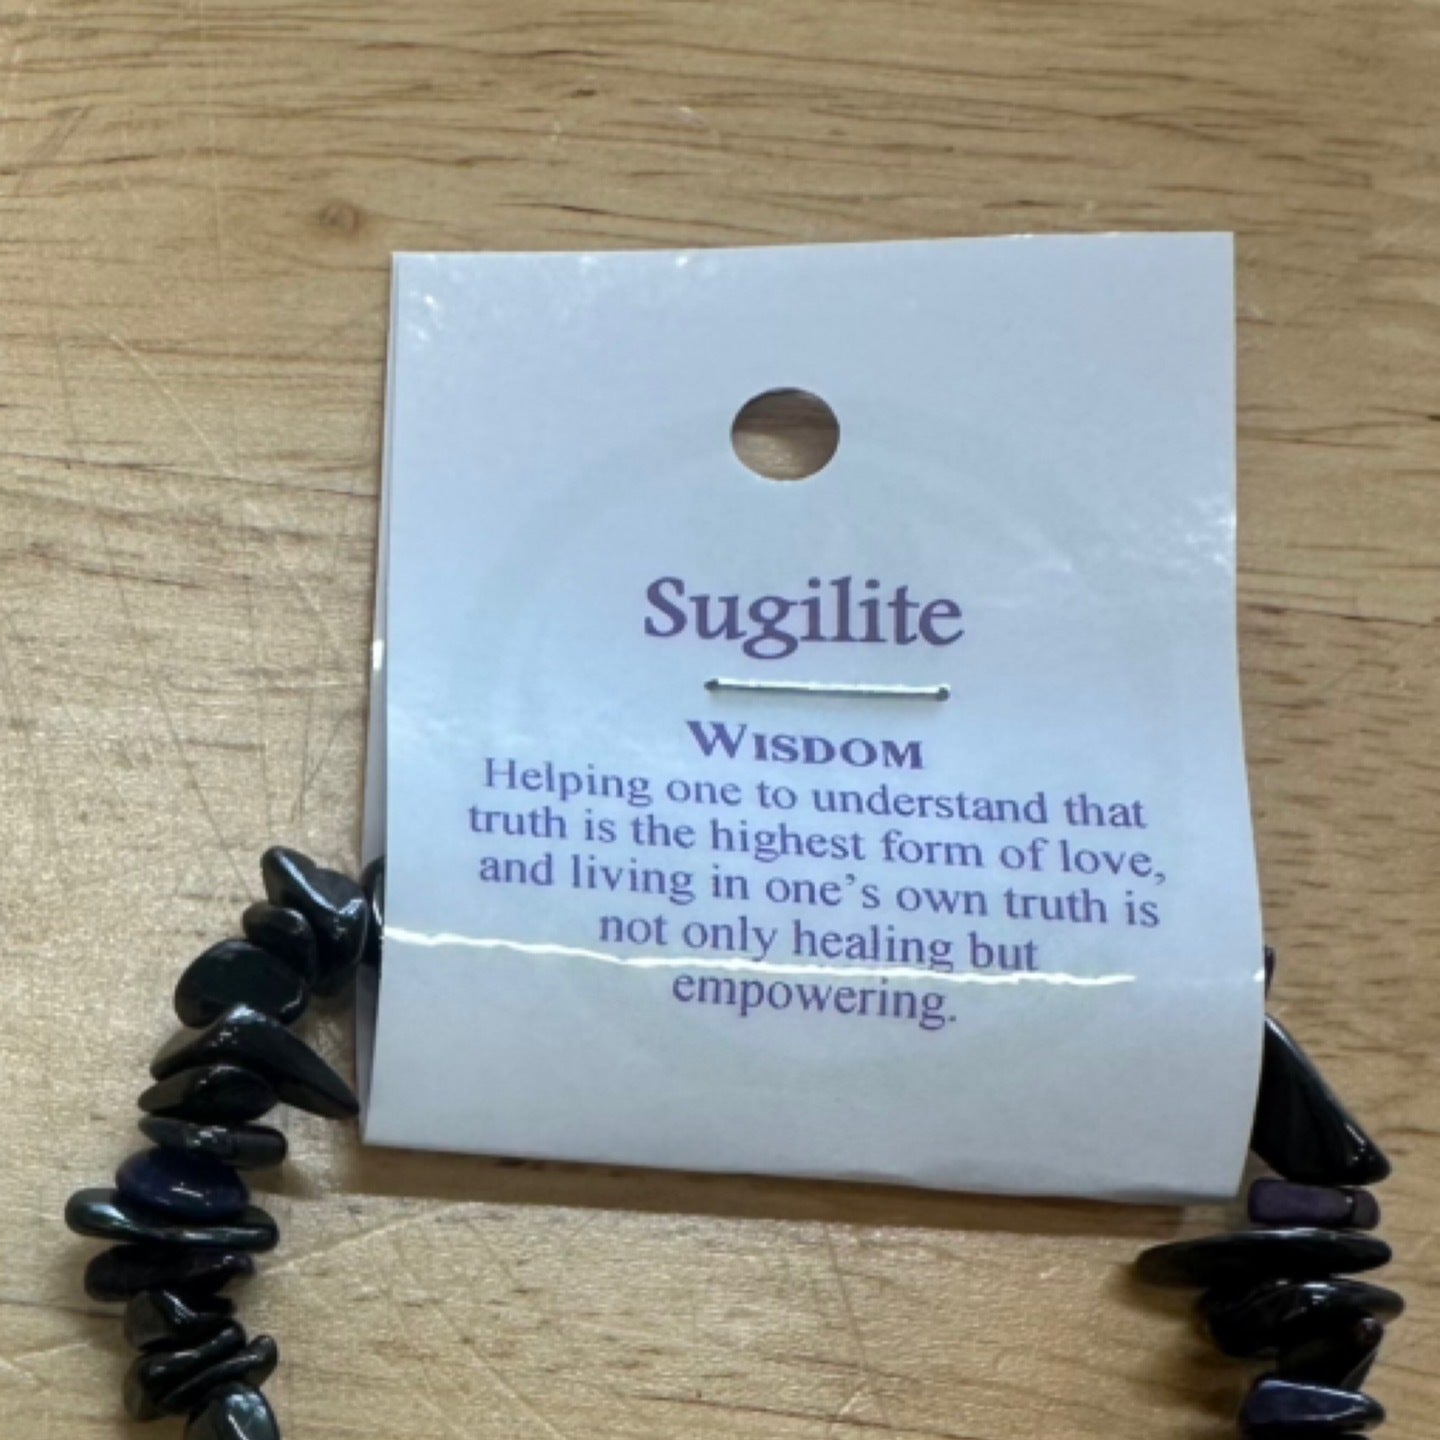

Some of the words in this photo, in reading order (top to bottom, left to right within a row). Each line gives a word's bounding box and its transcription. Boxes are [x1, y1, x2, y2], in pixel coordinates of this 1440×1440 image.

[644, 576, 964, 659] Sugilite
[686, 721, 923, 769] WISDOM
[486, 758, 653, 807] Helping
[666, 781, 741, 806] one
[757, 781, 797, 809] to
[813, 784, 1047, 824] understand
[1064, 793, 1147, 829] that
[468, 806, 566, 838] truth
[585, 809, 616, 843] is
[631, 814, 694, 849] the
[710, 818, 865, 863] highest
[881, 829, 983, 867] form
[1000, 837, 1048, 871] of
[1060, 840, 1165, 885] love,
[480, 853, 553, 886] and
[572, 854, 695, 905] living
[712, 867, 749, 900] in
[766, 874, 880, 908] one’s
[896, 888, 987, 916] own
[1004, 888, 1107, 923] truth
[1125, 890, 1160, 928] is
[600, 915, 667, 945] not
[682, 916, 777, 961] only
[794, 919, 953, 972] healing
[968, 931, 1038, 971] but
[673, 976, 956, 1031] empowering.
